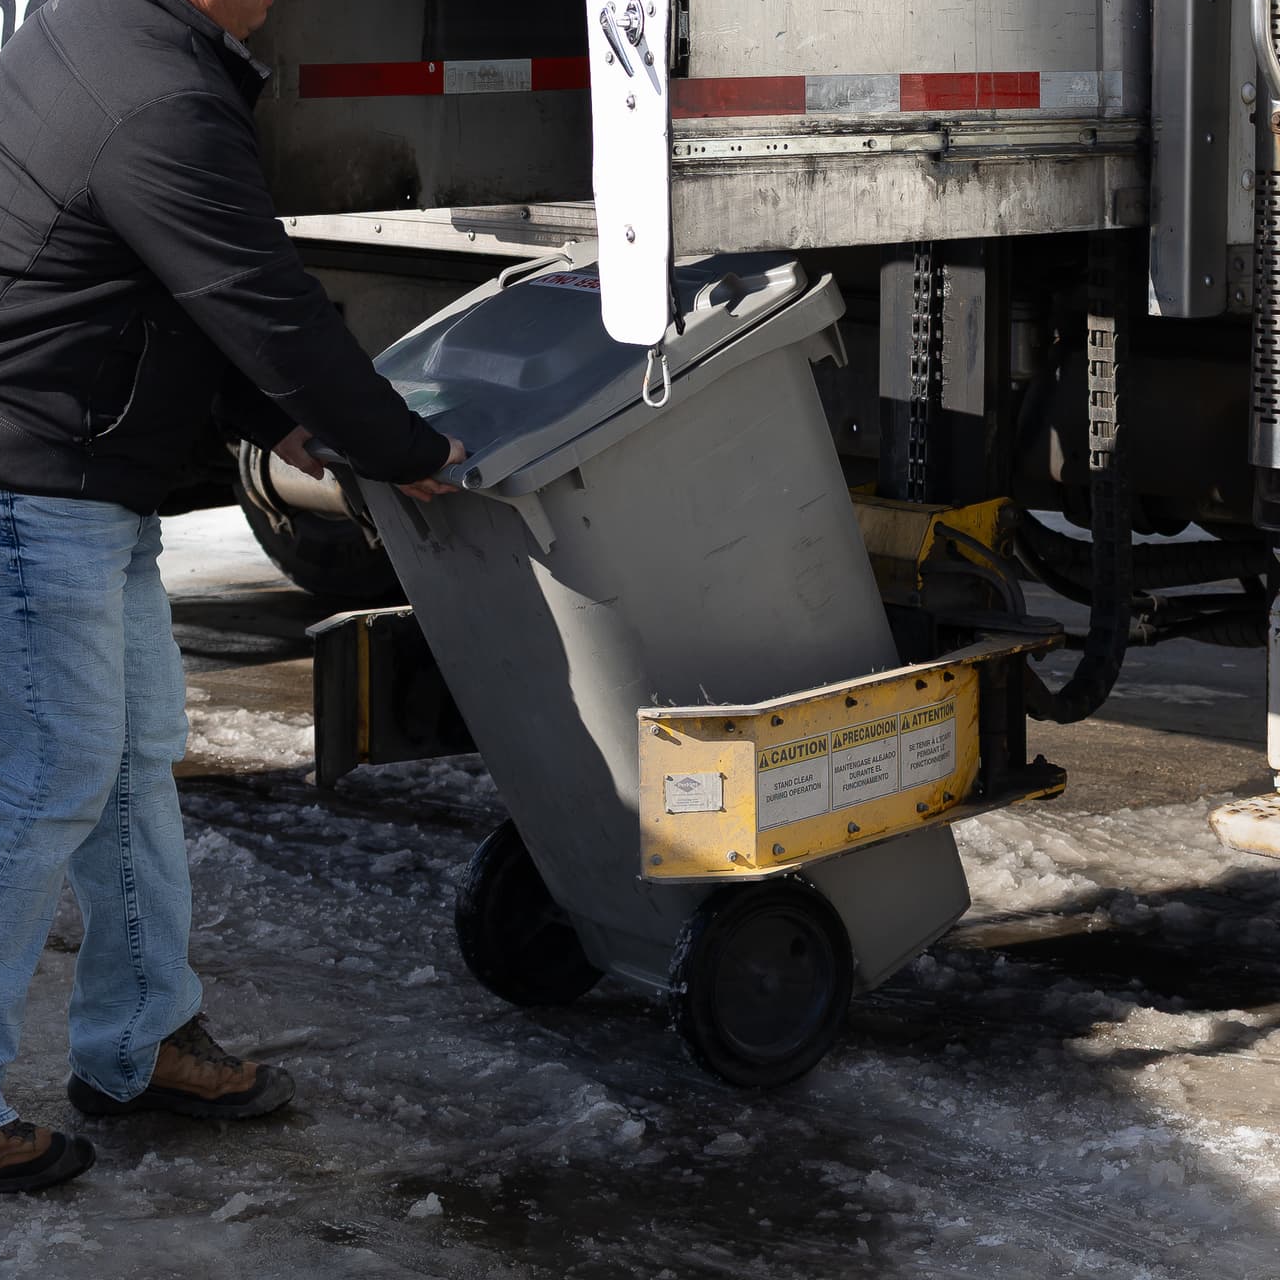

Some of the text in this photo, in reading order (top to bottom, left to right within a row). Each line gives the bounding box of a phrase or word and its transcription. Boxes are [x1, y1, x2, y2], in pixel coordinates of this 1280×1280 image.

[911, 701, 955, 727] ATTENTION
[842, 719, 897, 746] PRECAUCION
[771, 739, 827, 765] CAUTION
[872, 750, 897, 764] ALEJADO
[773, 774, 813, 791] STAND CLEAR
[849, 764, 882, 780] DURANTE EL
[766, 781, 822, 803] DURING OPERATION
